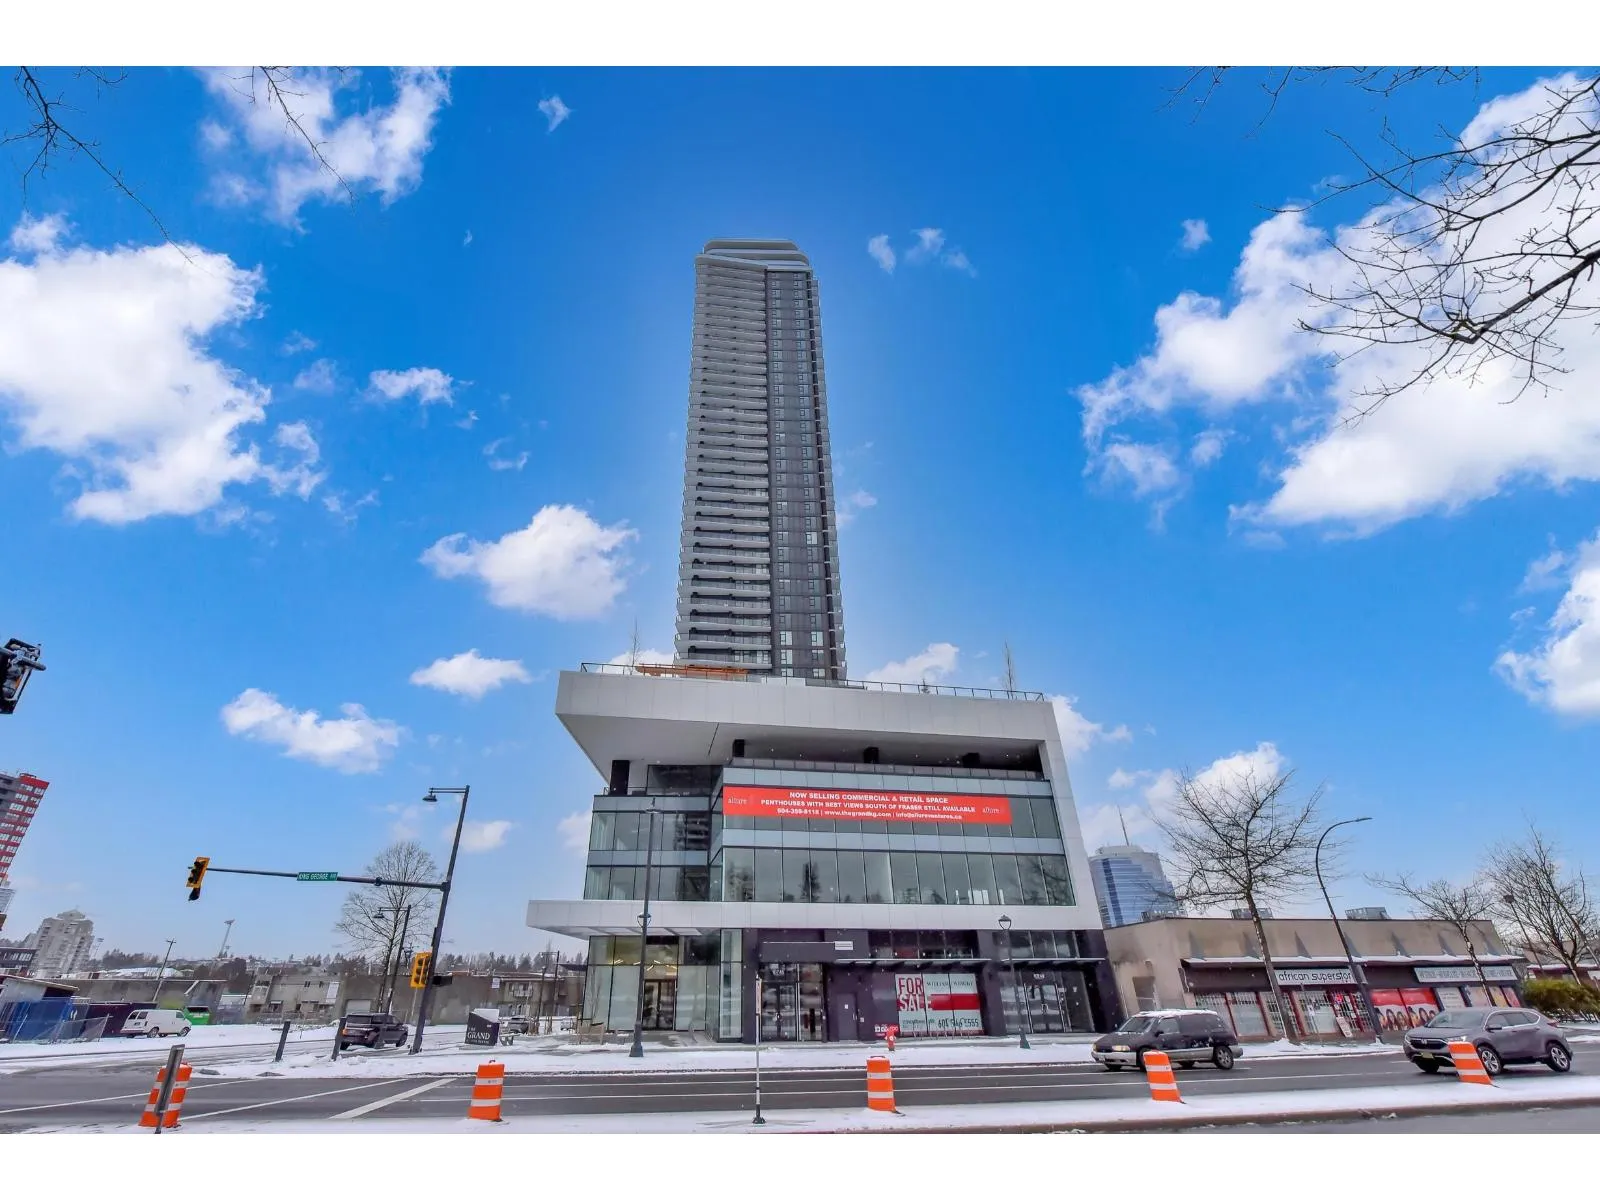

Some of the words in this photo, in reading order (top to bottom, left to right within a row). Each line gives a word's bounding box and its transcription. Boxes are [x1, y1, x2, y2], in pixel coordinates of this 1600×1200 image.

[808, 792, 840, 800] SELLING
[842, 794, 890, 802] COMMERCIAL
[760, 799, 805, 807] PENTHOUSES
[1278, 971, 1310, 981] african
[898, 977, 923, 995] FOR
[467, 1032, 490, 1040] GRAND
